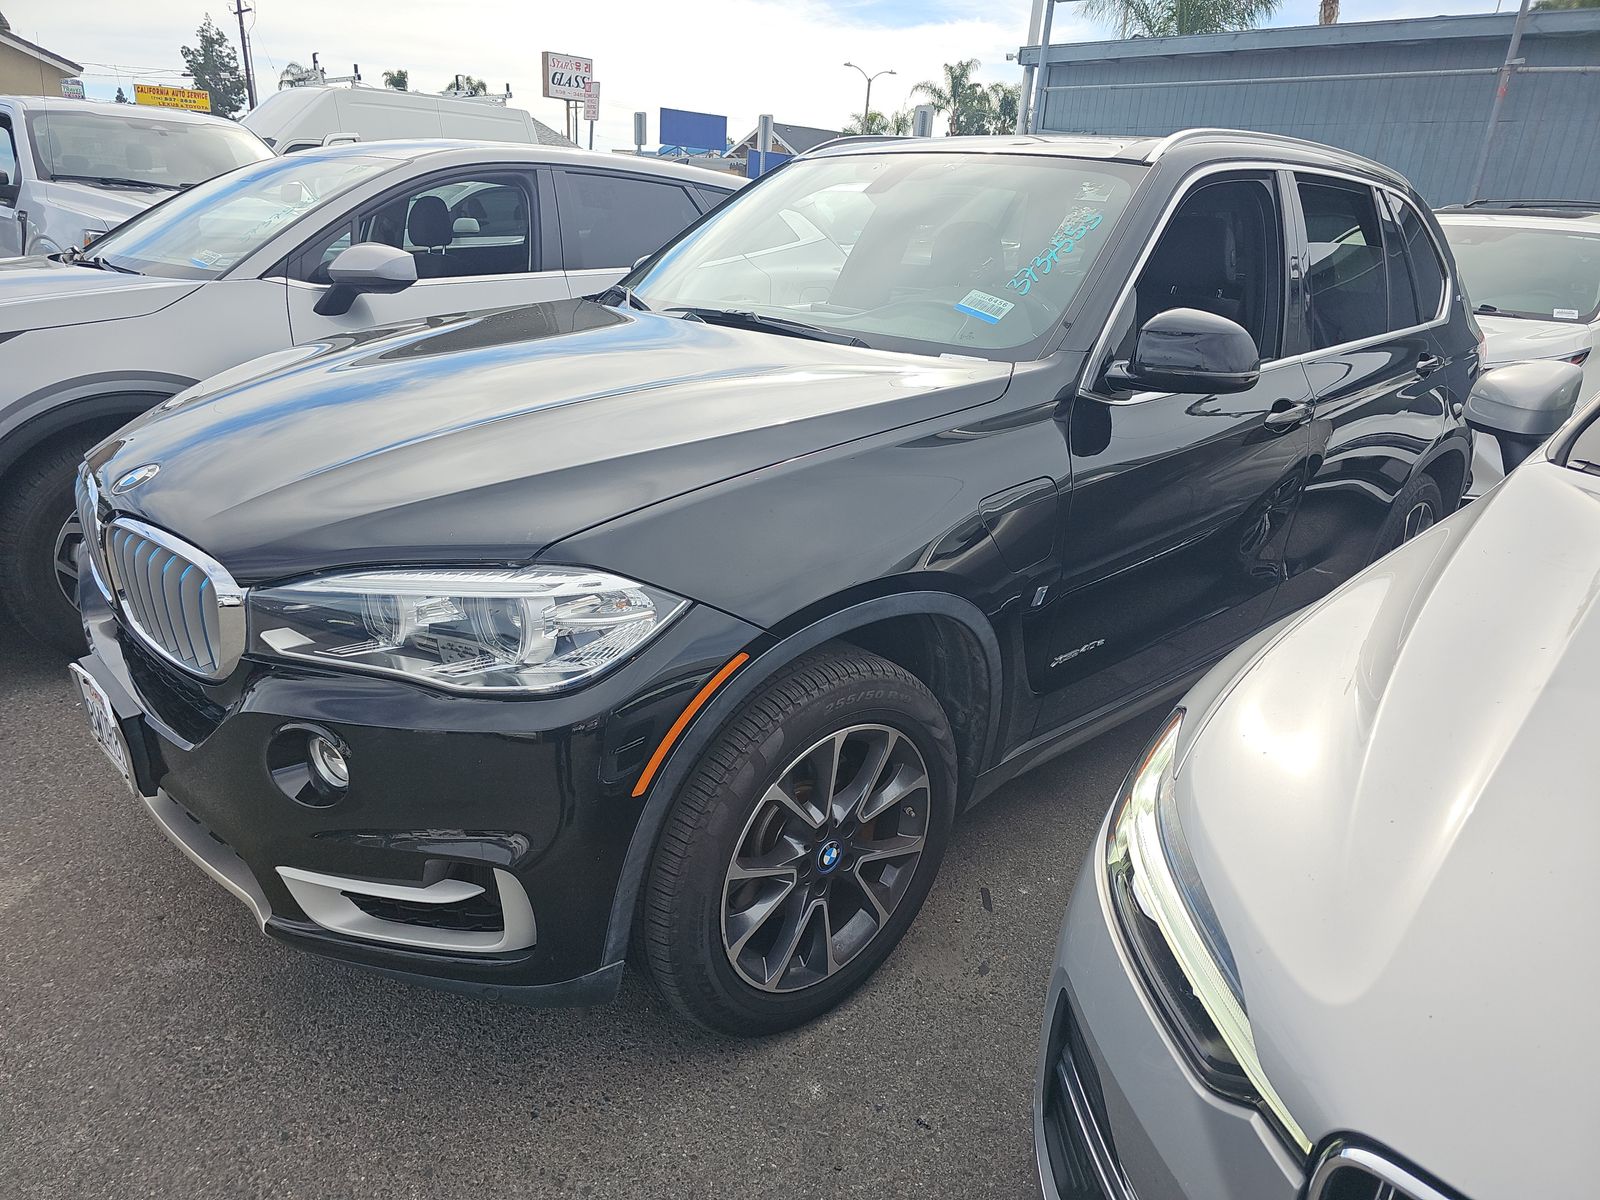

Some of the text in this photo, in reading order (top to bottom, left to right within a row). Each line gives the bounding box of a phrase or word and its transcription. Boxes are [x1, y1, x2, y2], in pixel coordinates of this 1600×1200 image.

[552, 72, 590, 89] GLASS
[137, 86, 208, 100] CALIFORNIA AUTO SERVICE
